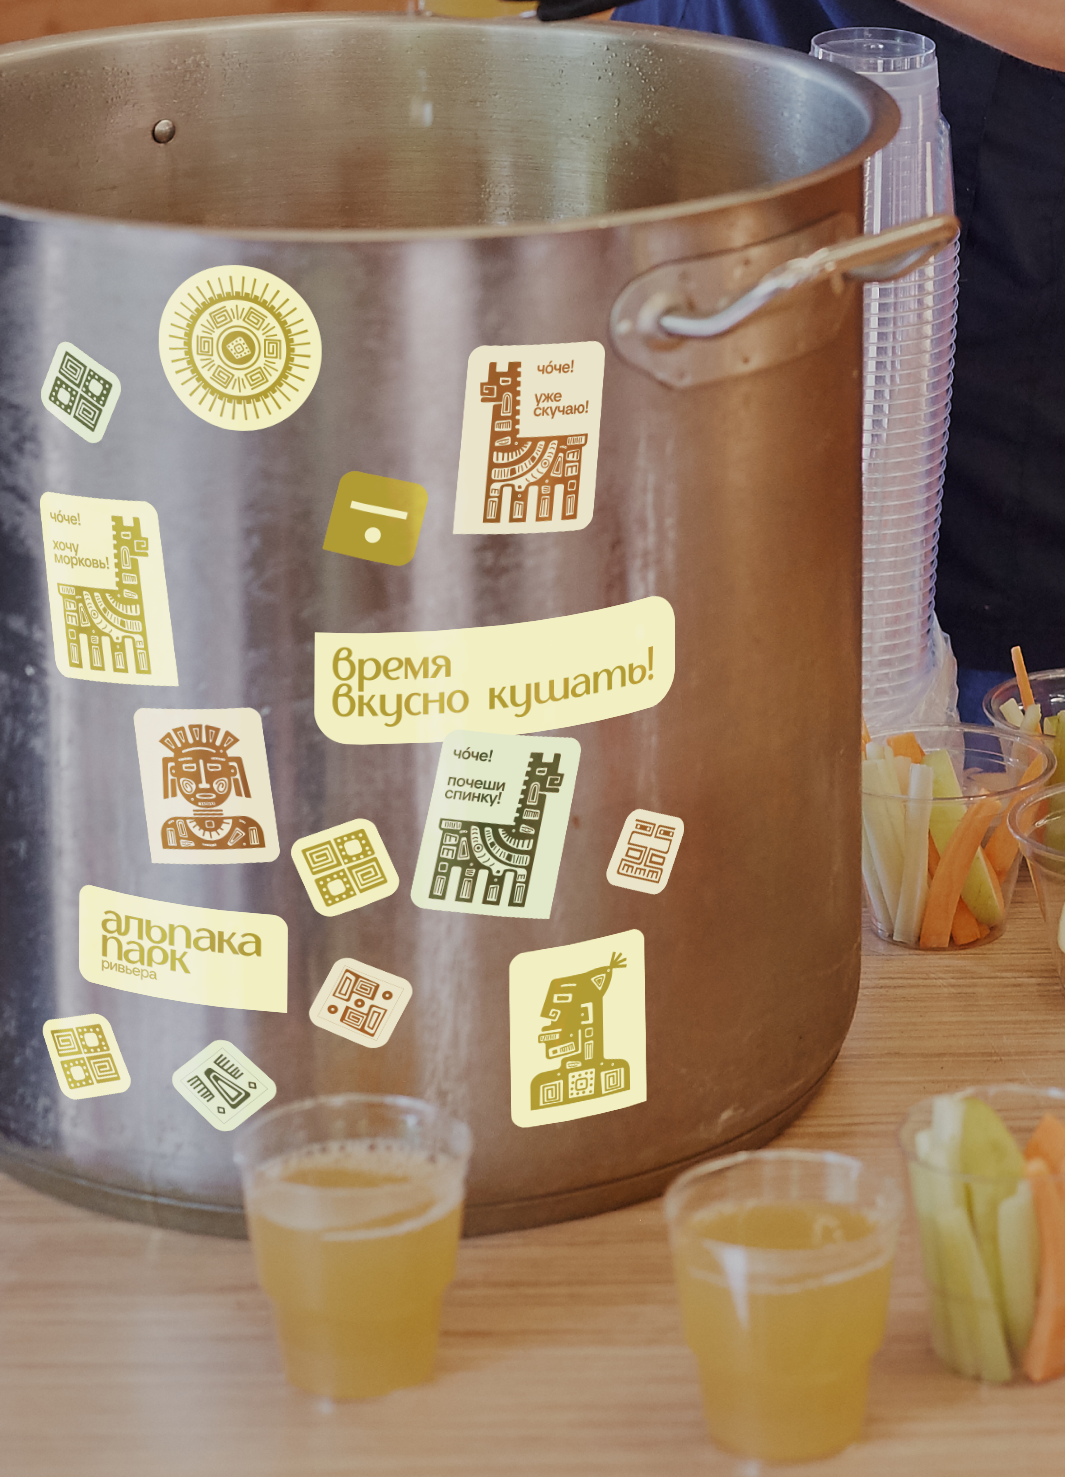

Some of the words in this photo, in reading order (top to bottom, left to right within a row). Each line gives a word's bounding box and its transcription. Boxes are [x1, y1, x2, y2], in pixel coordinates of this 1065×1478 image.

[534, 392, 563, 407] уже
[533, 400, 589, 420] скучаю!
[52, 539, 80, 557] хочу
[54, 553, 110, 570] морковь!
[332, 646, 452, 693] время
[332, 682, 470, 728] вкусно
[488, 645, 655, 719] кушать!
[447, 776, 506, 792] почеши
[444, 789, 503, 807] спинку!
[101, 909, 262, 958] альпака
[101, 933, 192, 975] парк
[101, 958, 158, 981] ривьера
